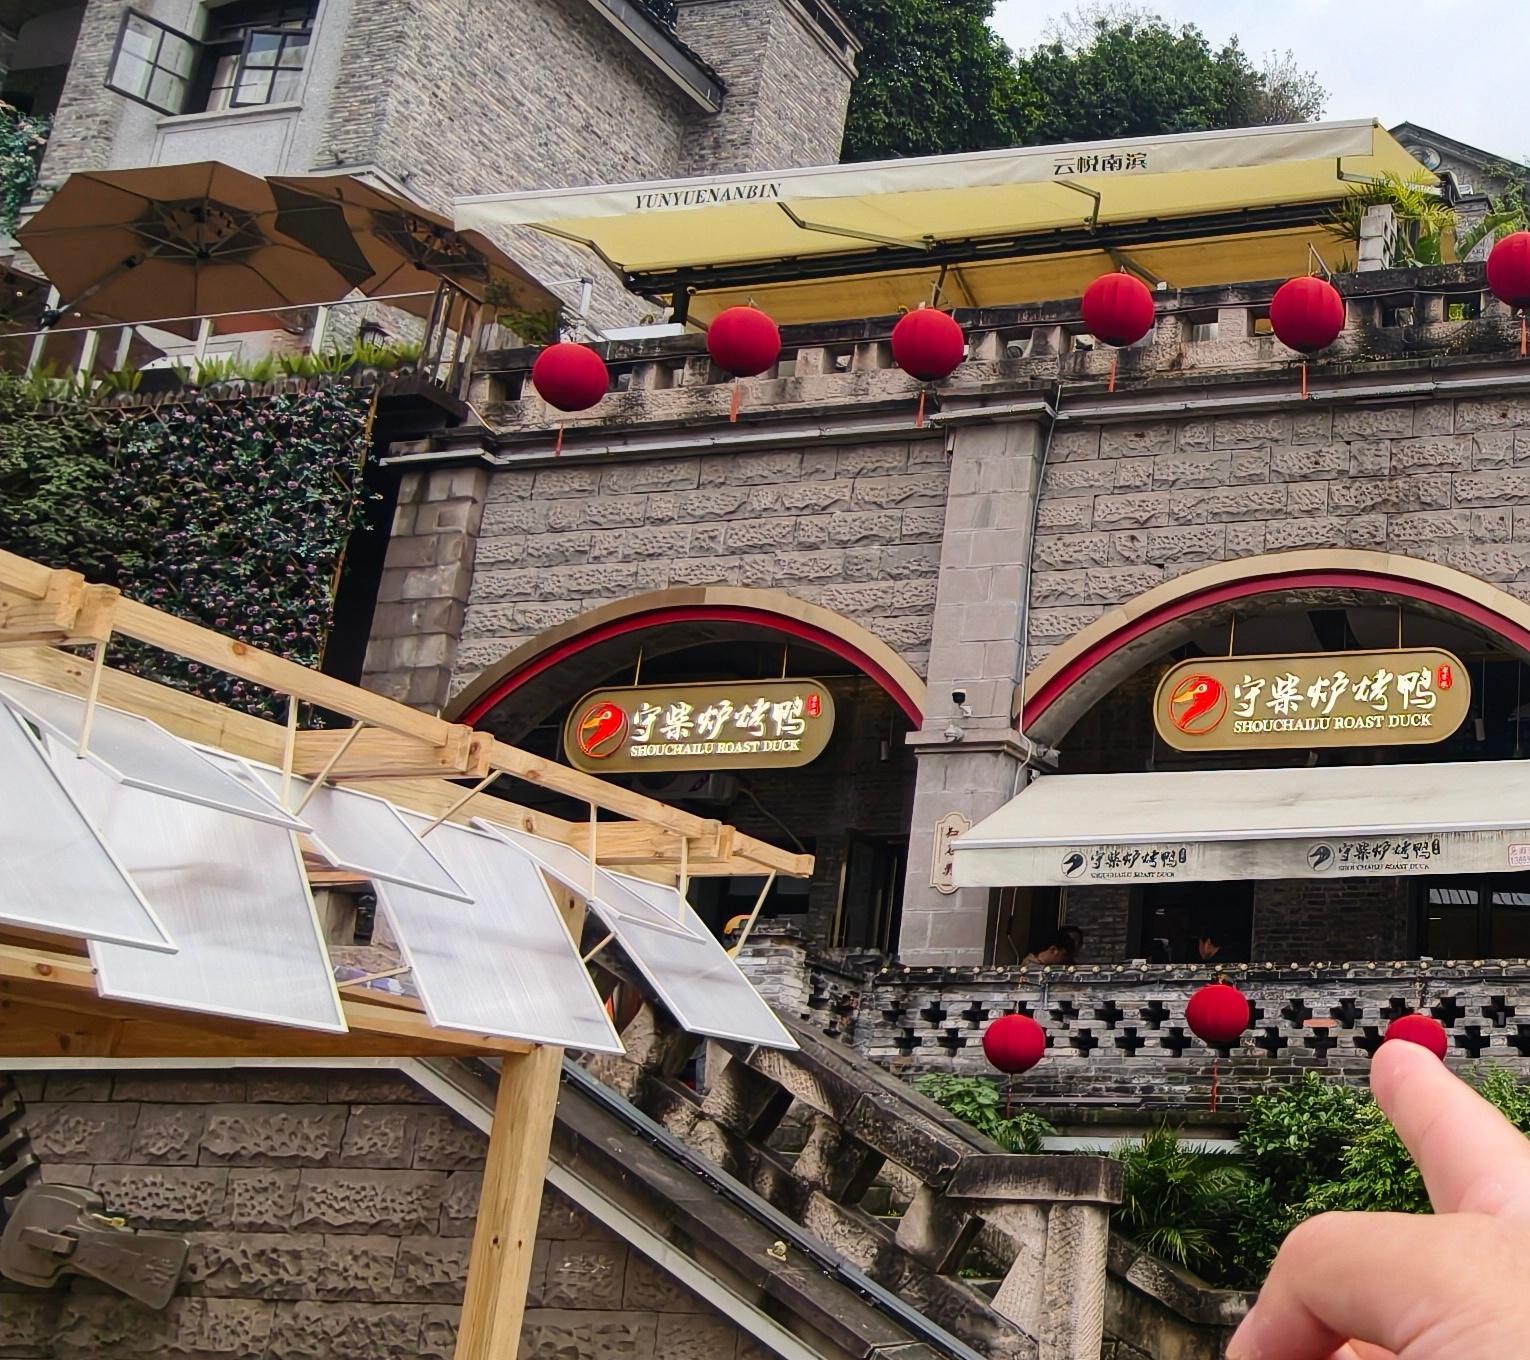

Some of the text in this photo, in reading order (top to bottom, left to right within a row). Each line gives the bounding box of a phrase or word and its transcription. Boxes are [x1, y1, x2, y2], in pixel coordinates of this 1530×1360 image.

[1053, 152, 1147, 175] 云悦南滨
[636, 183, 781, 208] YUNYUENANBIN
[1233, 667, 1436, 718] 守柴炉烤鸭
[630, 696, 805, 741] 守柴炉烤鸭
[1233, 713, 1432, 733] SHOUCHAILU ROAST DUCK
[630, 739, 801, 757] SHOUCHAILU ROAST DUCK
[1091, 849, 1177, 869] 守柴炉烤鸭
[1339, 840, 1431, 861] 守柴炉烤鸭
